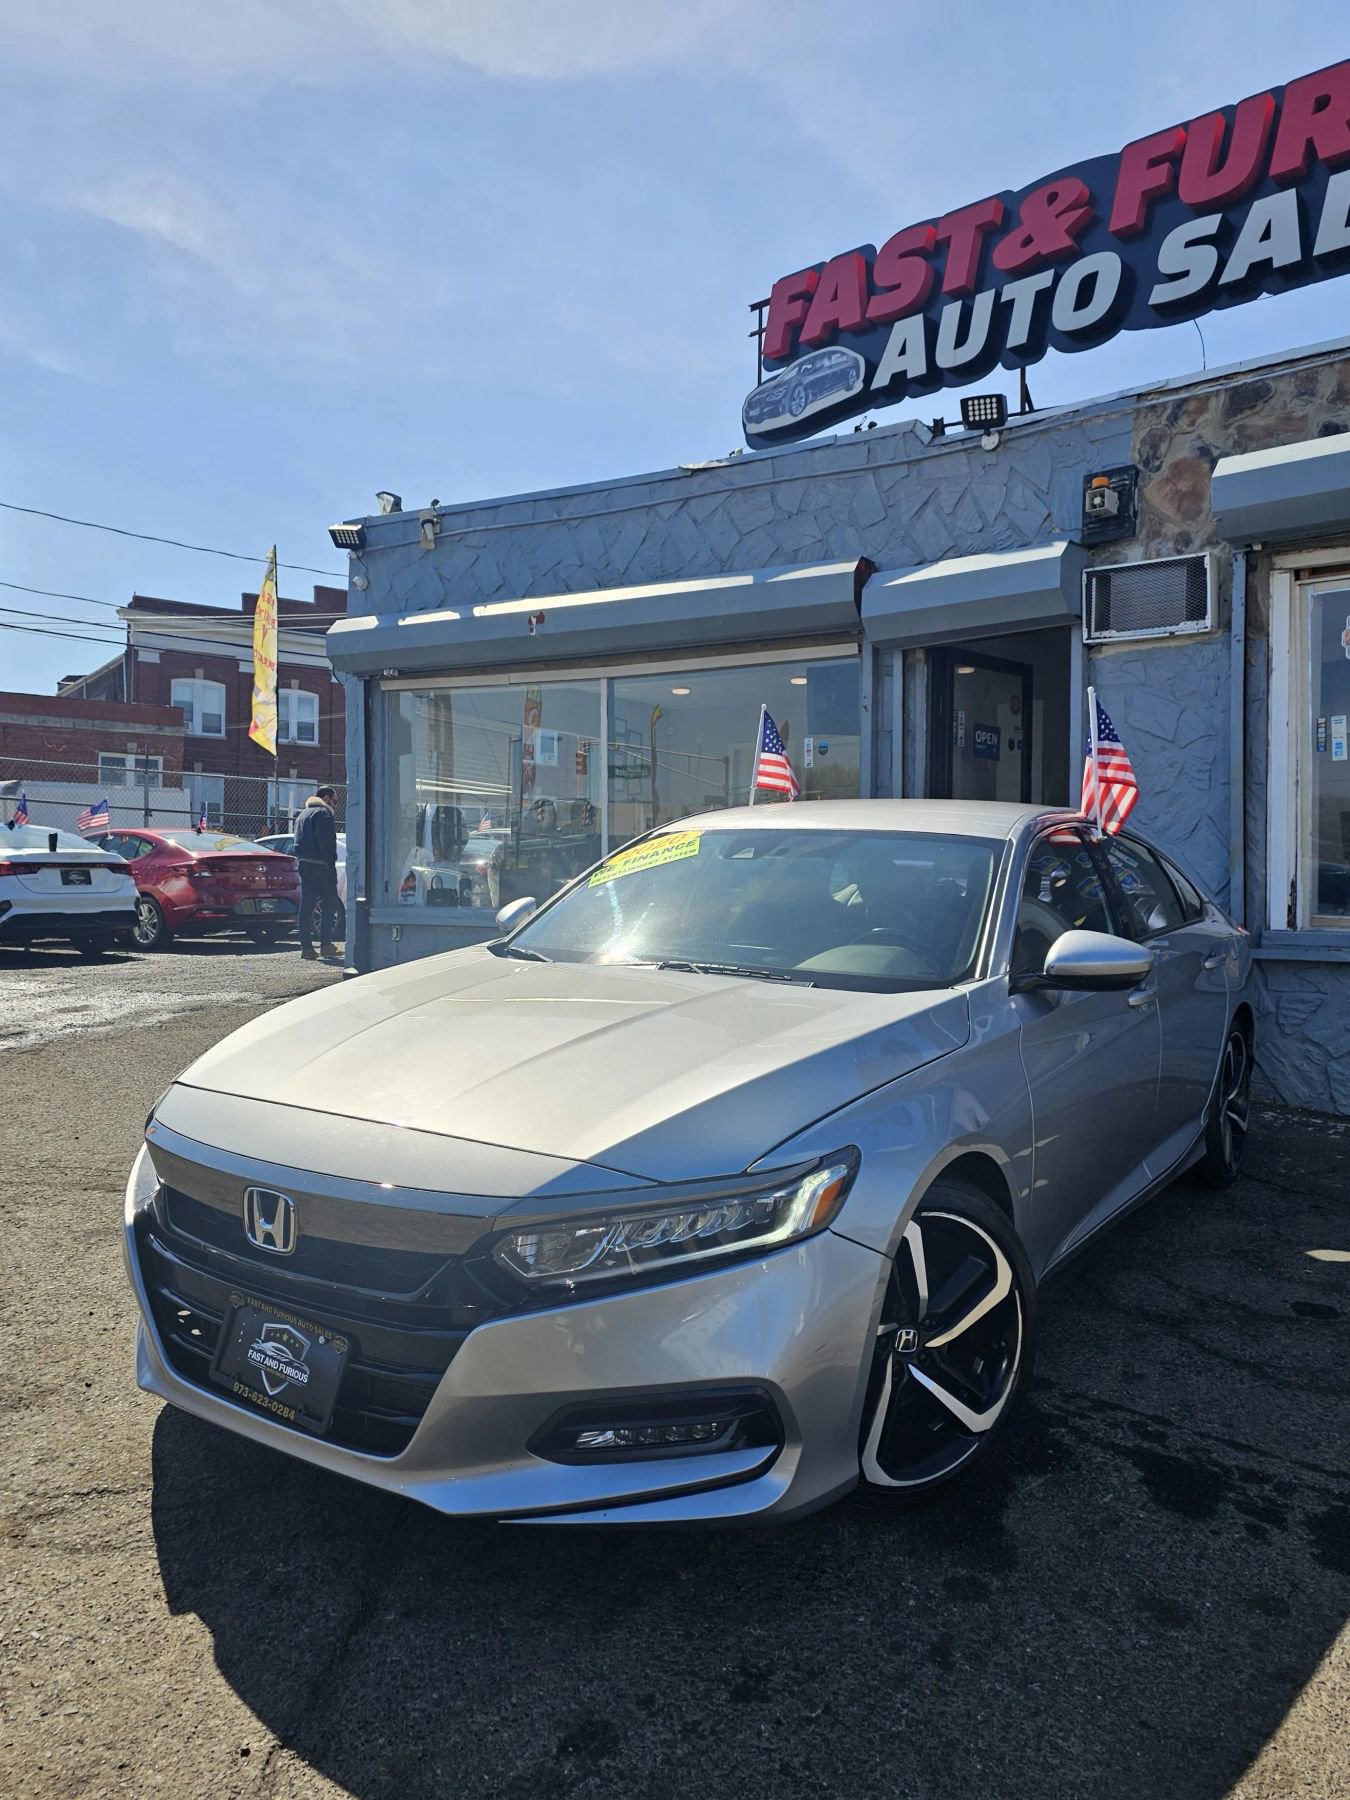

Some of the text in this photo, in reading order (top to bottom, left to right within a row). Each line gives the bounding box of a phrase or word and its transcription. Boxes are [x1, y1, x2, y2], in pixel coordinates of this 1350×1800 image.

[763, 199, 1004, 359] FAST
[992, 177, 1097, 271] &
[870, 251, 1122, 391] AUTO
[976, 730, 998, 744] OPEN
[623, 839, 697, 867] FINANCE
[247, 1349, 265, 1363] FAST
[264, 1356, 279, 1370] AND
[278, 1363, 309, 1383] FURIOUS
[232, 1382, 296, 1421] 973-623-0284
